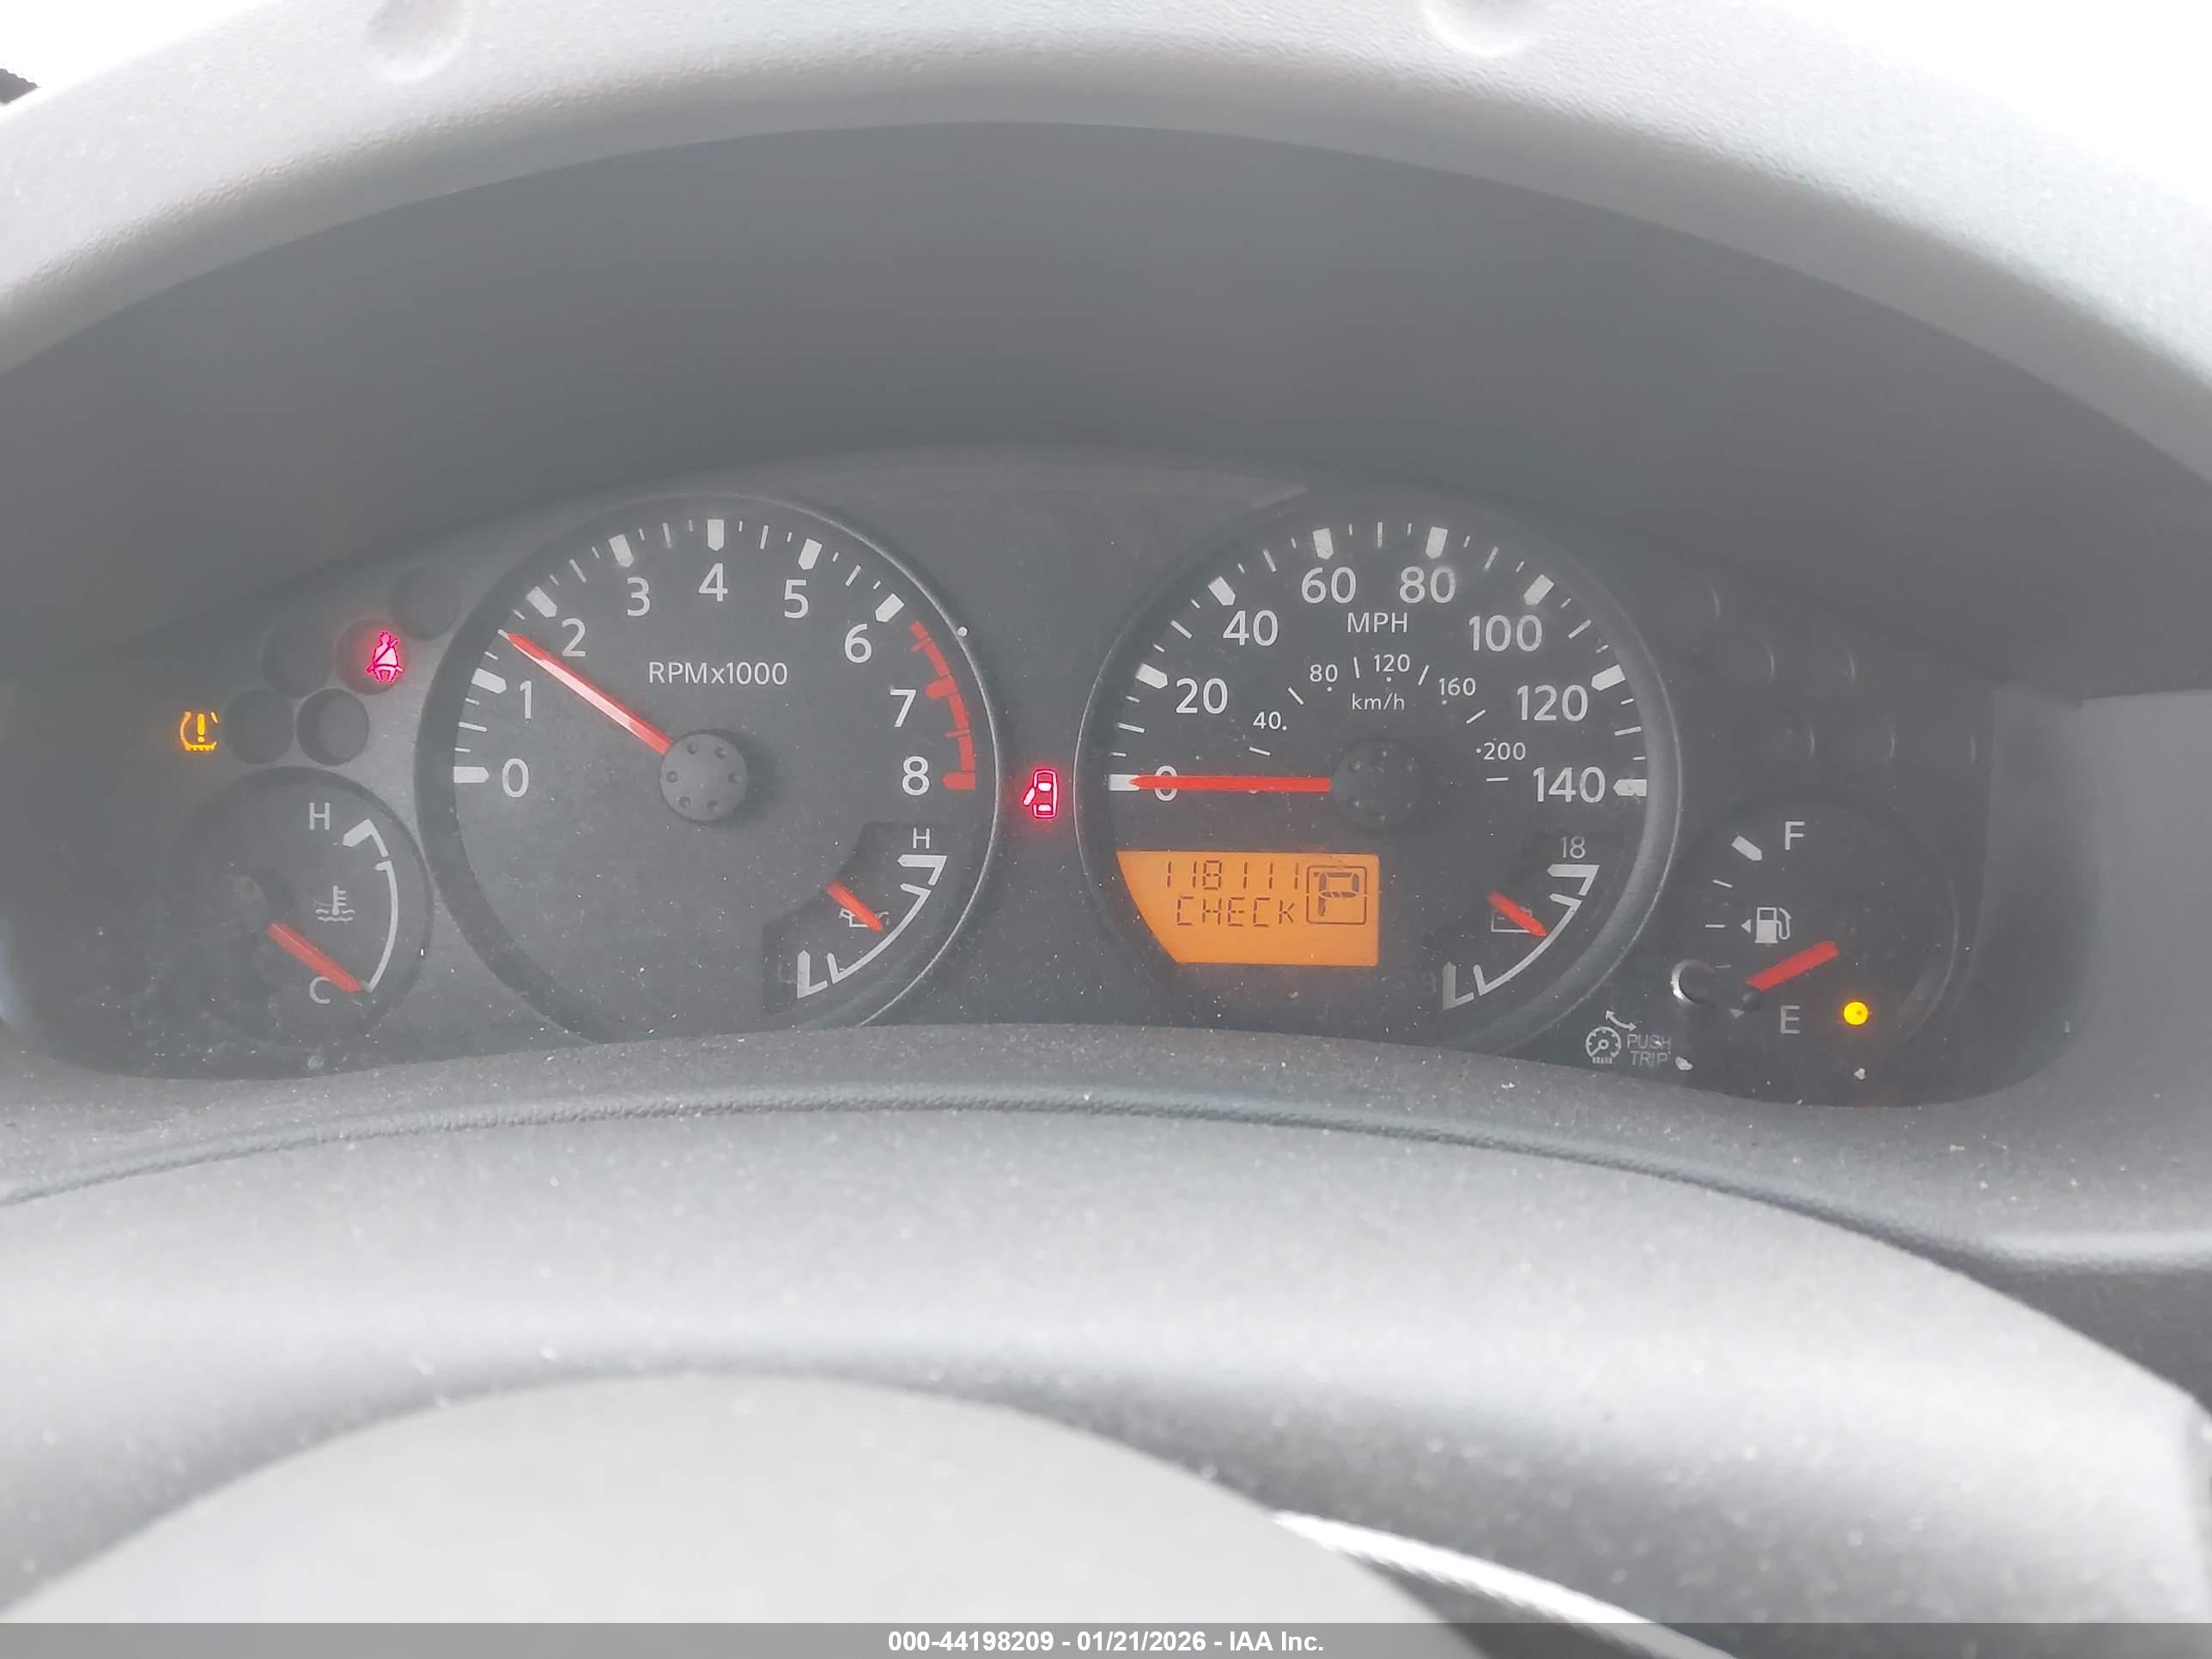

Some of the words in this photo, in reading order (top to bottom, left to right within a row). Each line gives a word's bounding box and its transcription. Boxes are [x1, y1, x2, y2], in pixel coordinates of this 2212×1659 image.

[628, 577, 650, 616] 3
[699, 563, 727, 601] 4
[1302, 568, 1356, 603] 60
[1400, 567, 1455, 603] 80
[785, 580, 808, 618] 5
[562, 618, 586, 656] 2
[1223, 611, 1278, 646] 40
[1348, 612, 1407, 632] MPH
[1469, 616, 1541, 651] 100
[845, 623, 872, 663] 6
[650, 662, 787, 684] RPMx1000
[1310, 665, 1337, 682] 80
[1375, 654, 1410, 672] 120
[520, 681, 532, 718] 1
[1176, 678, 1227, 714] 20
[1352, 693, 1404, 709] km/h
[1439, 678, 1475, 696] 160
[1517, 685, 1587, 721] 120
[890, 690, 916, 726] 7
[1253, 712, 1280, 729] 40
[1484, 743, 1525, 760] 200
[502, 759, 528, 797] 0
[902, 757, 929, 795] 8
[1155, 766, 1177, 800] 0
[1534, 767, 1605, 803] 140
[310, 803, 330, 830] H
[913, 829, 930, 848] H
[1563, 838, 1585, 859] 18
[1785, 822, 1804, 850] F
[1166, 860, 1299, 890] 118111
[1313, 872, 1360, 917] P
[1176, 896, 1295, 927] CHECK
[310, 976, 330, 1004] C
[1780, 1006, 1800, 1034] E
[1626, 1033, 1672, 1053] PUSH
[1631, 1051, 1668, 1066] TRIP
